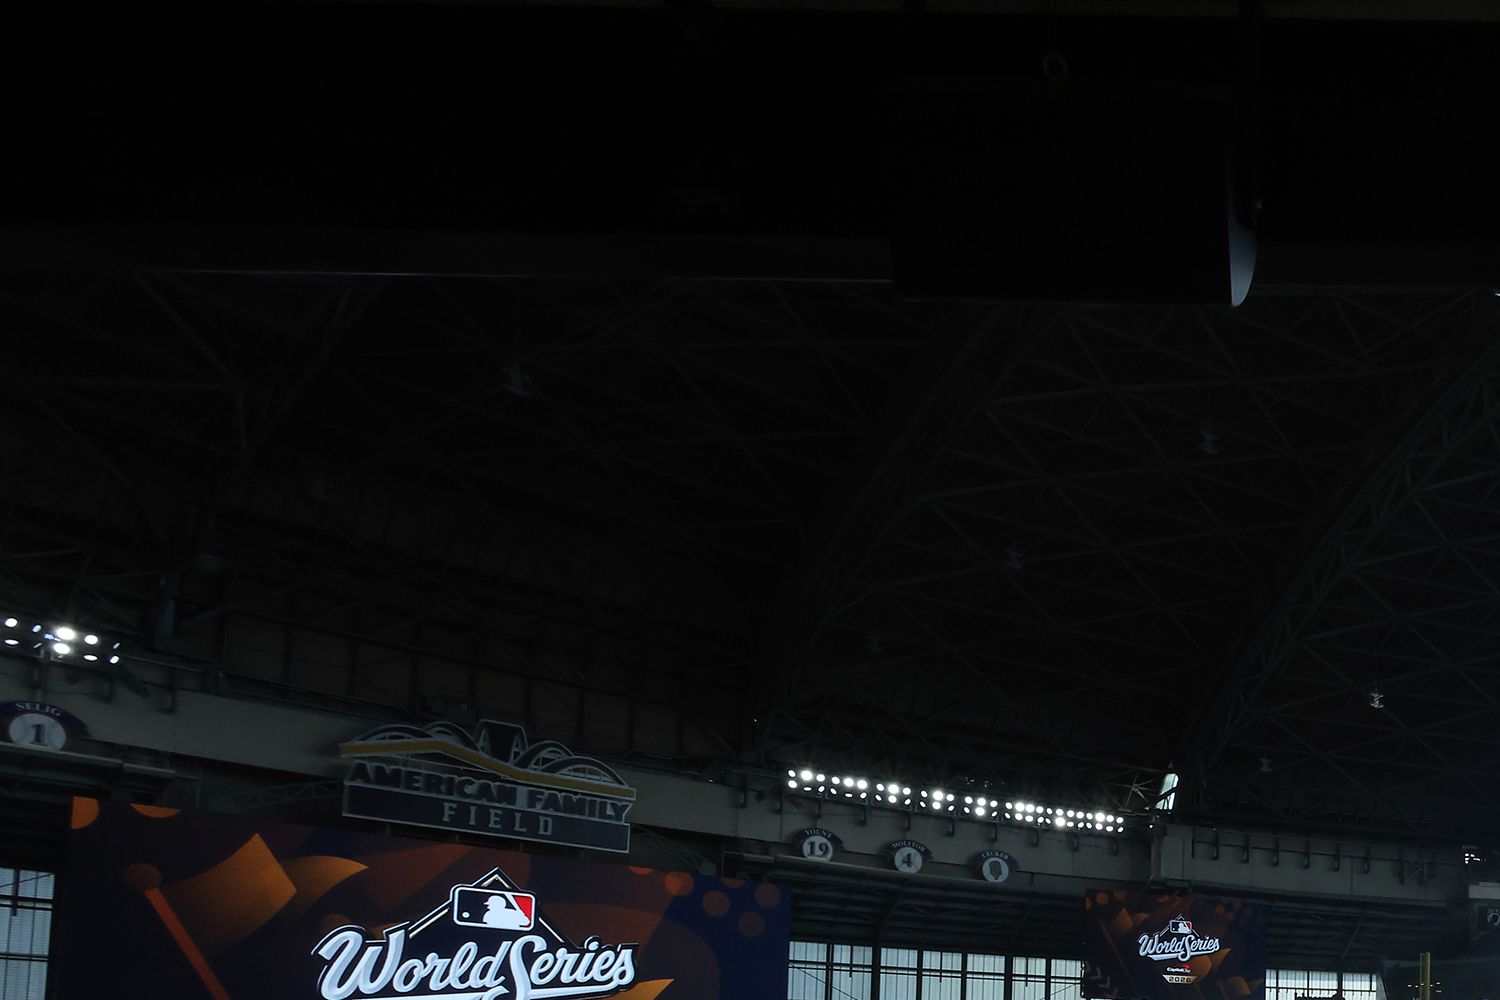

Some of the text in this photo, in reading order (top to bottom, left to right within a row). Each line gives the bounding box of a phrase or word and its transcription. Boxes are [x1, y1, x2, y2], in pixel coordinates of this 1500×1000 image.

[31, 723, 48, 747] 1
[350, 761, 634, 823] AMERICAN FAMILY
[441, 800, 554, 836] FIELD
[804, 829, 834, 841] YOUNT
[807, 840, 829, 858] 19
[891, 840, 926, 853] MOLITOR
[902, 853, 913, 868] 4
